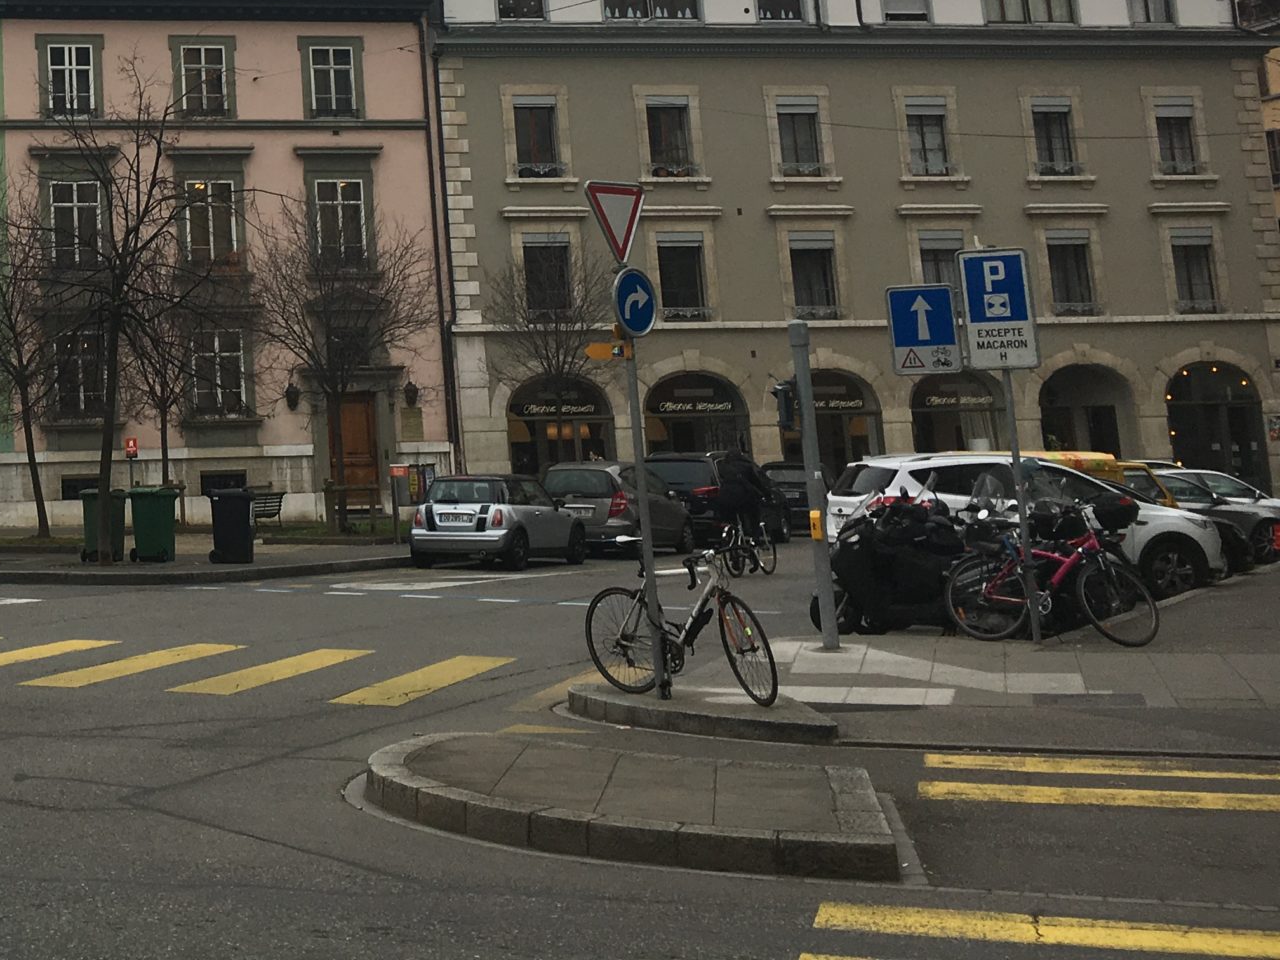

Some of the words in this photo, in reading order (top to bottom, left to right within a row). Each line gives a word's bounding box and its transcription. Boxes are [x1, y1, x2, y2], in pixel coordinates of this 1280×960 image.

[982, 260, 1006, 292] P
[977, 328, 1024, 339] EXCEPTE
[976, 340, 1028, 350] MACARON
[1000, 352, 1008, 361] H
